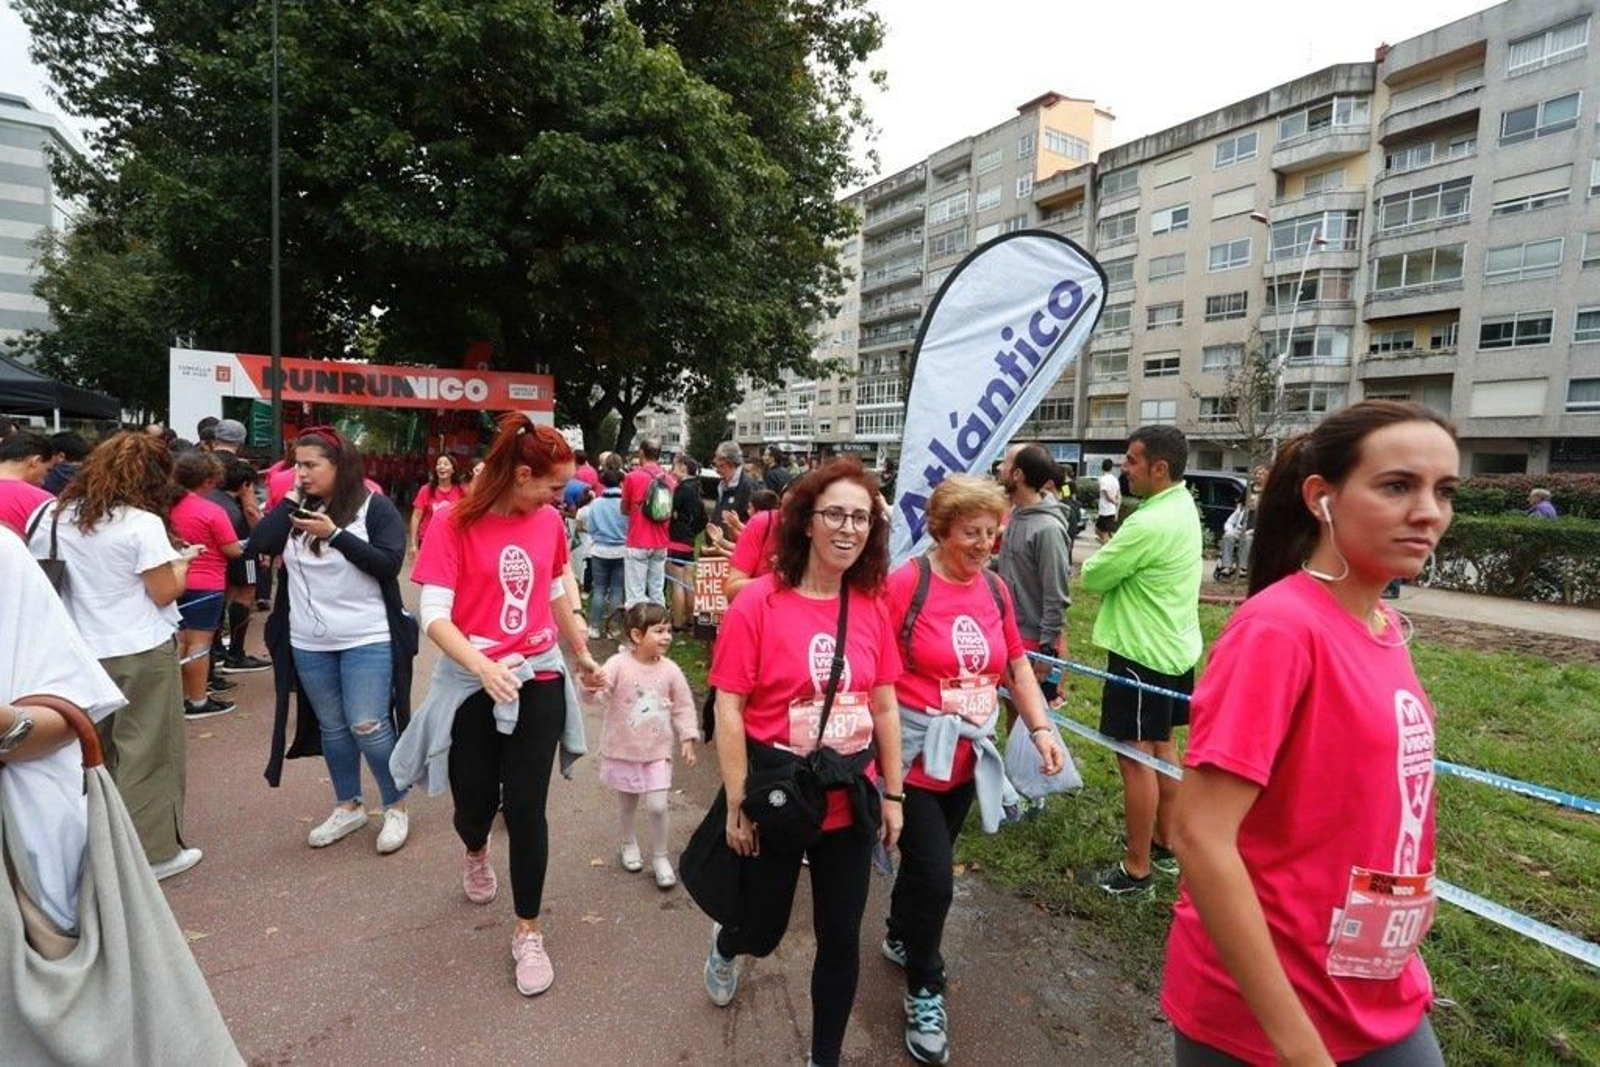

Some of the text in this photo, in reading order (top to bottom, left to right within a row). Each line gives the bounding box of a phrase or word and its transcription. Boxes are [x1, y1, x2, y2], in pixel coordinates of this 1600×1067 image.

[899, 279, 1084, 546] Atlántico
[696, 561, 729, 578] SAVE
[696, 579, 723, 594] THE
[694, 595, 728, 610] MUS
